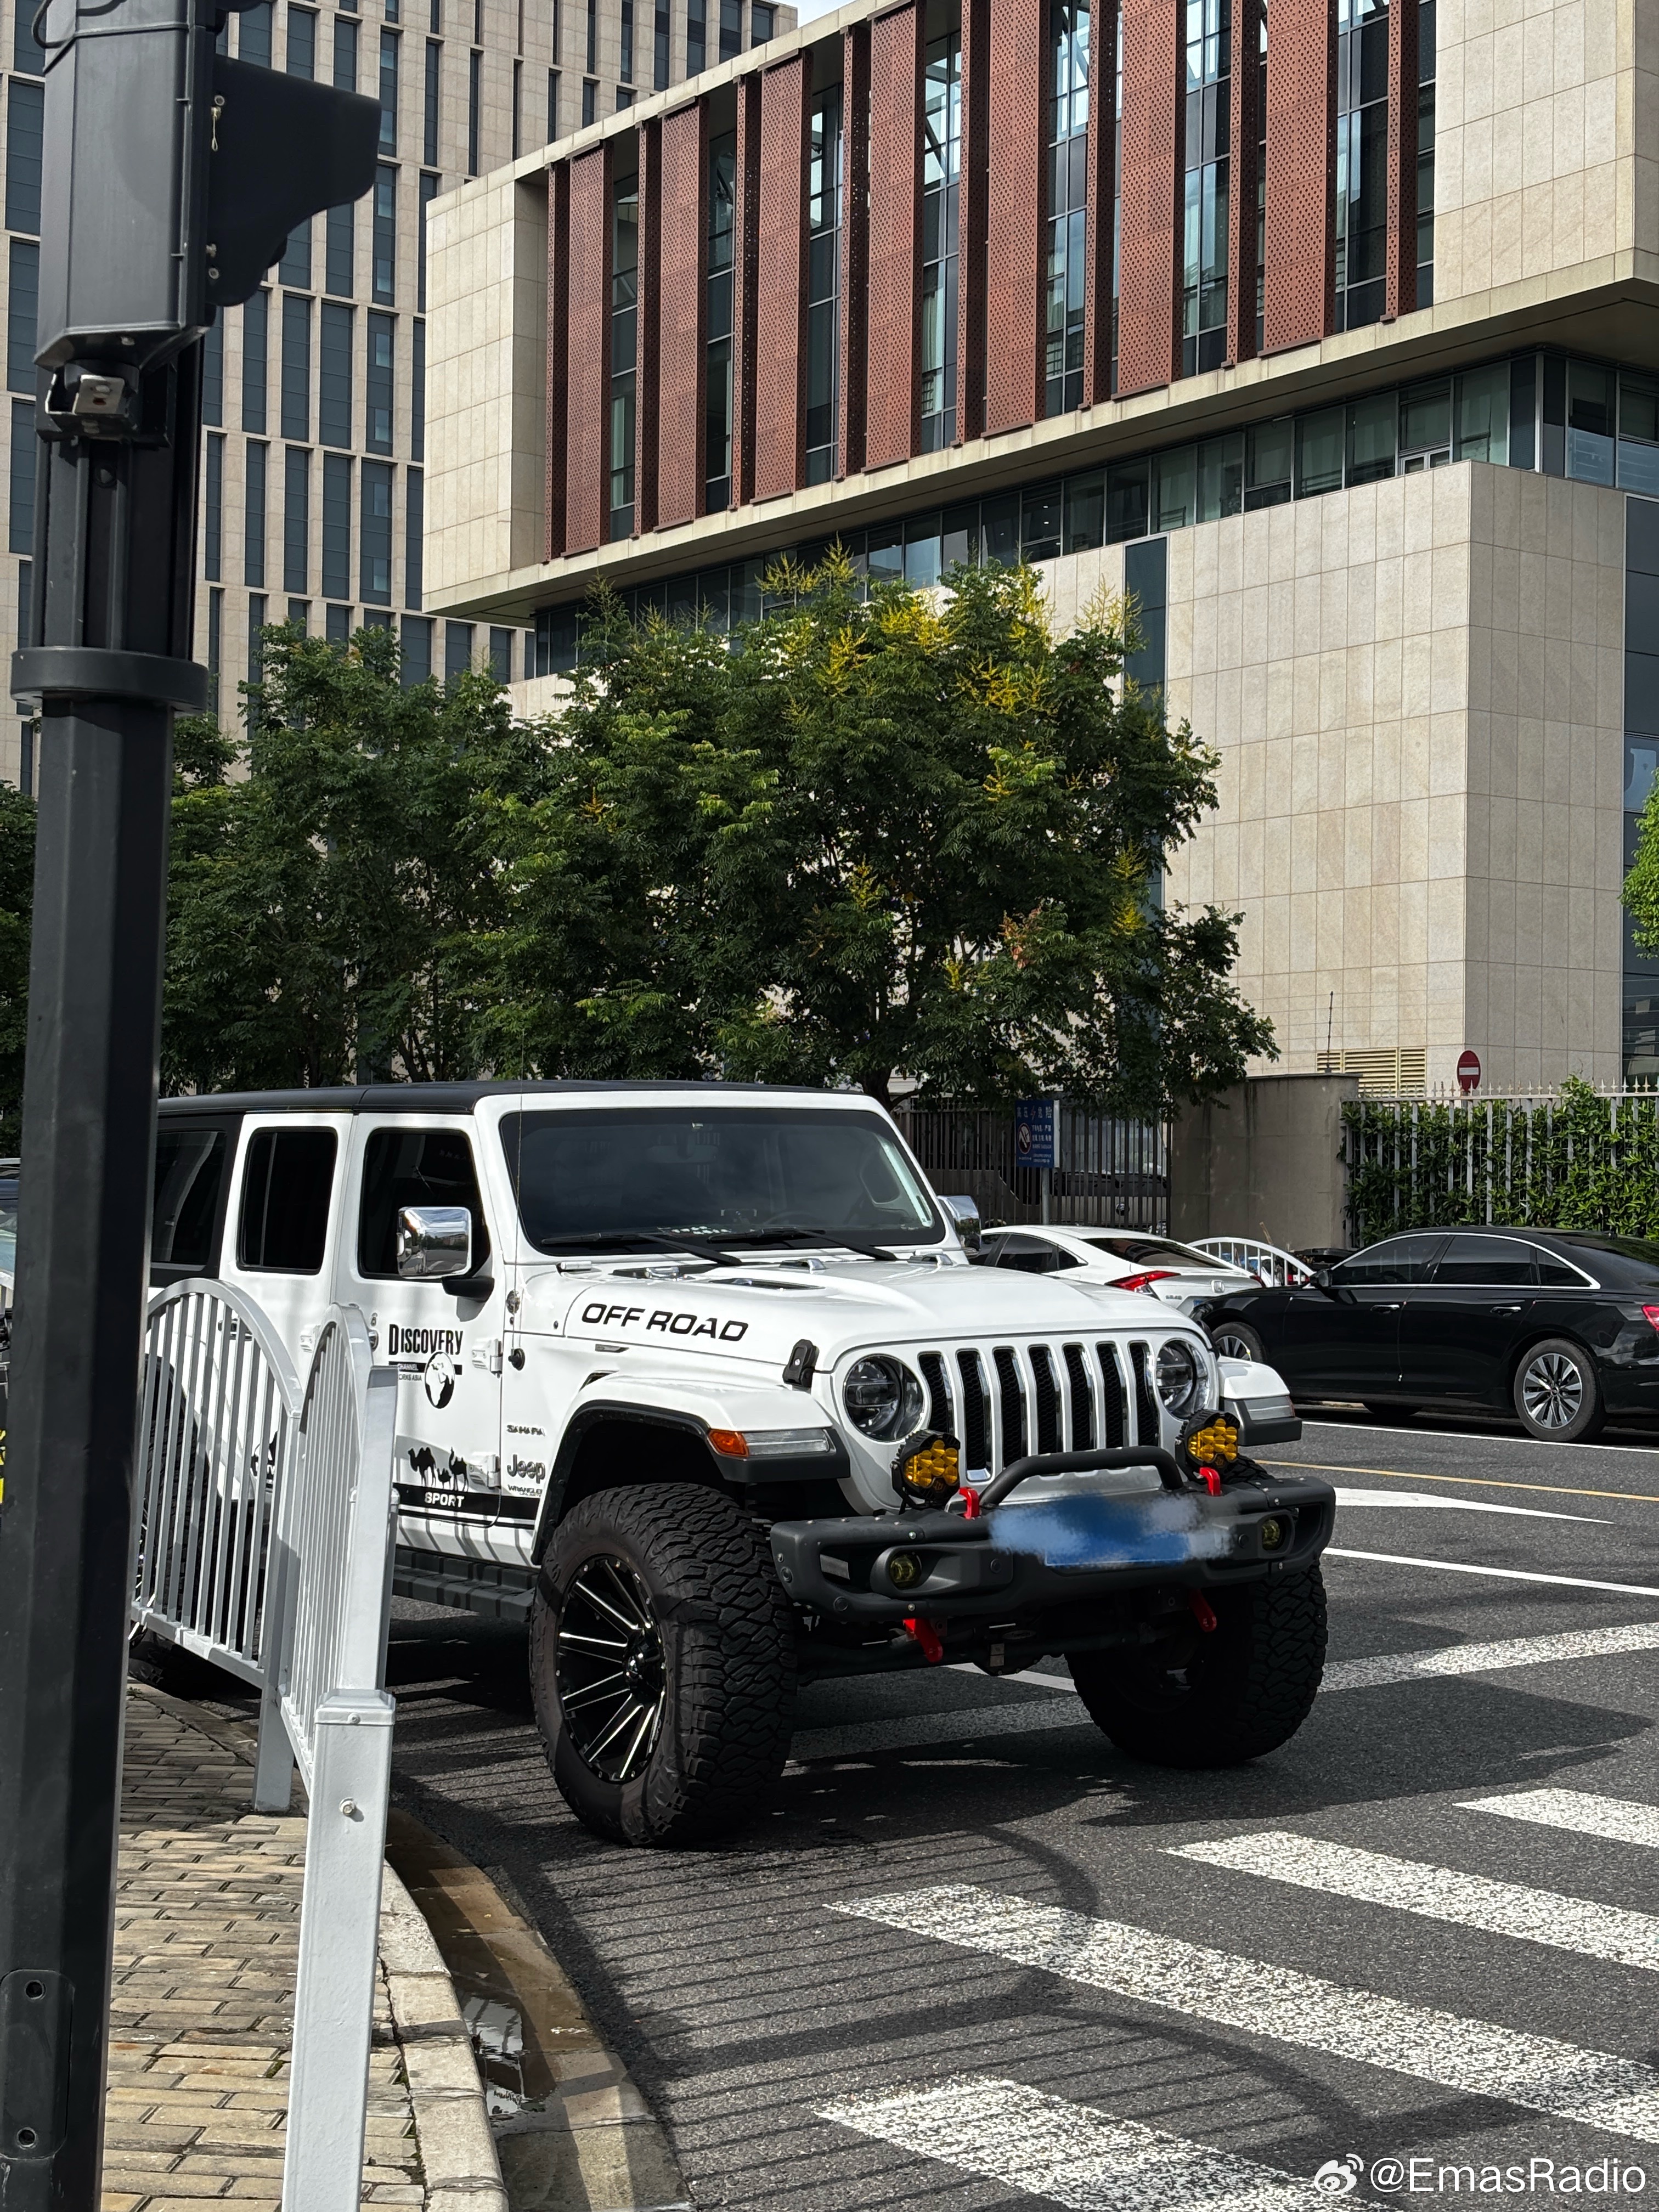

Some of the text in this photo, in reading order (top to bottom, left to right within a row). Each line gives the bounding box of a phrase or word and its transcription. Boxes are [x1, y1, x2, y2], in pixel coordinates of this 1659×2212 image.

[582, 1303, 749, 1342] OFF ROAD
[388, 1324, 464, 1356] DISCOVERY
[506, 1454, 546, 1485] Jeep
[424, 1492, 465, 1508] SPORT
